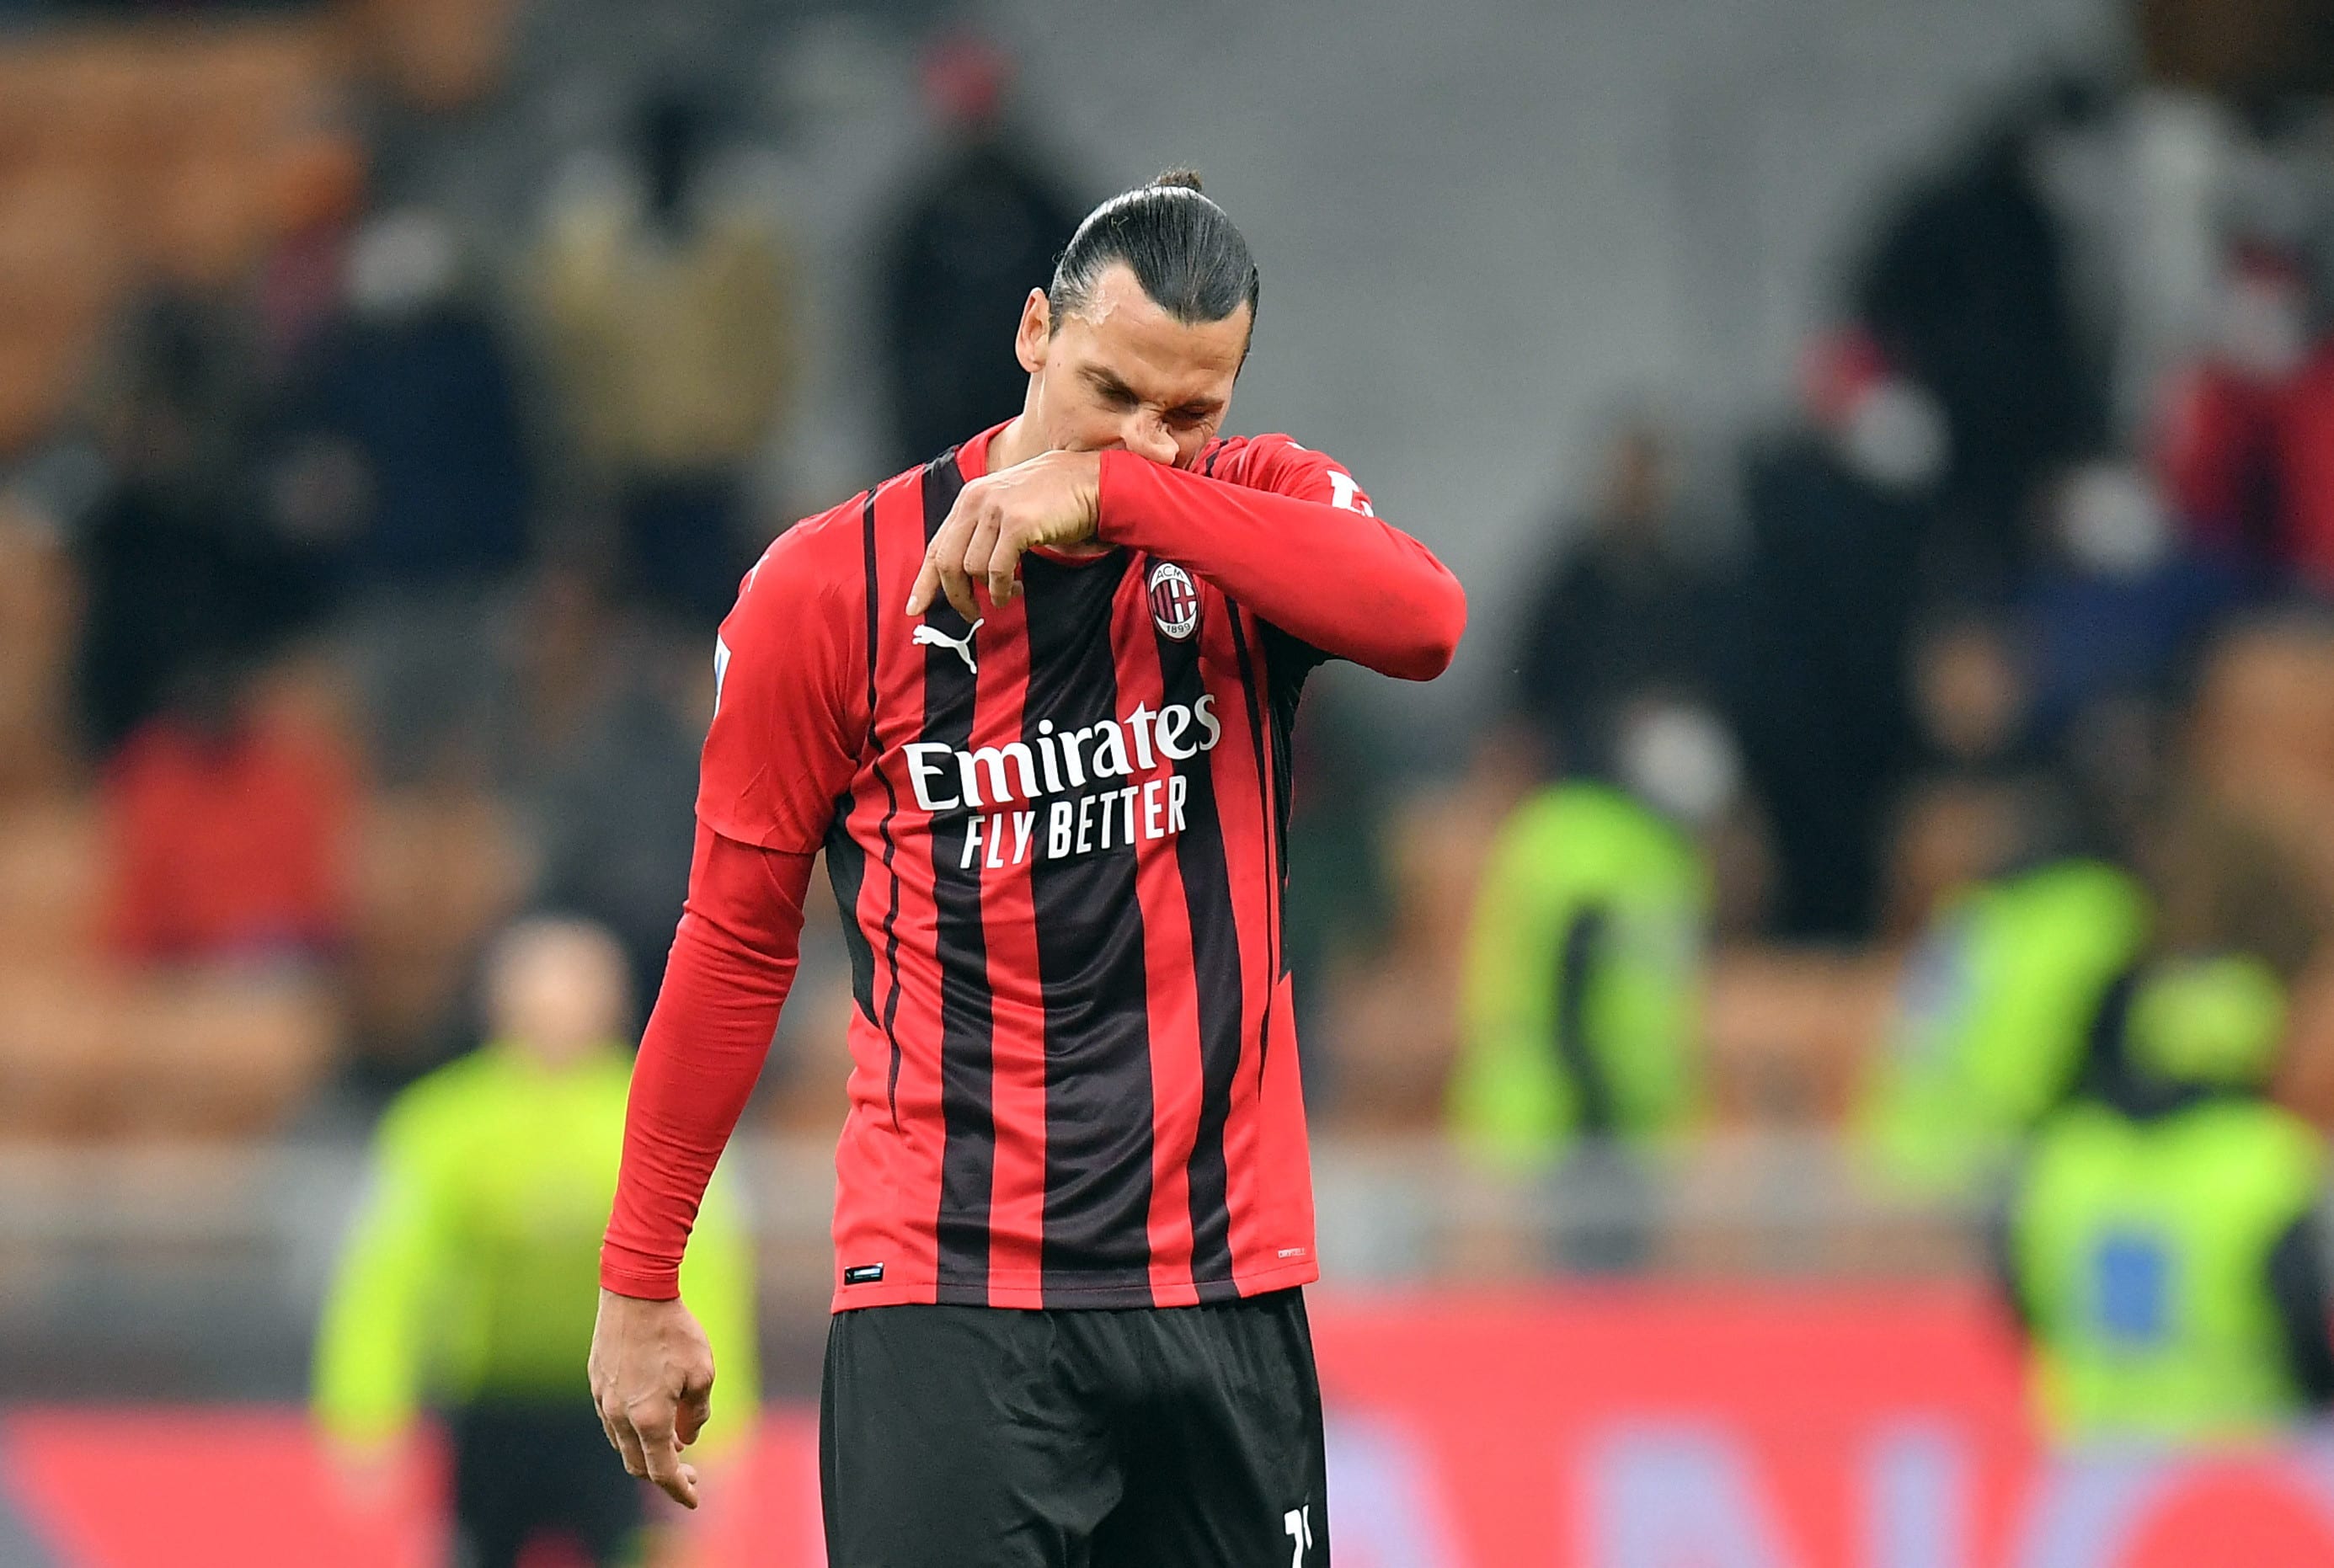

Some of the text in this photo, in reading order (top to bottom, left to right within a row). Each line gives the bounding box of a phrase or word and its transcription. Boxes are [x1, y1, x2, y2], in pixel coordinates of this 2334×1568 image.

[1155, 565, 1184, 583] ACM
[1166, 623, 1191, 634] 1899
[901, 694, 1221, 811] Emirates
[959, 775, 1187, 869] FLY BETTER
